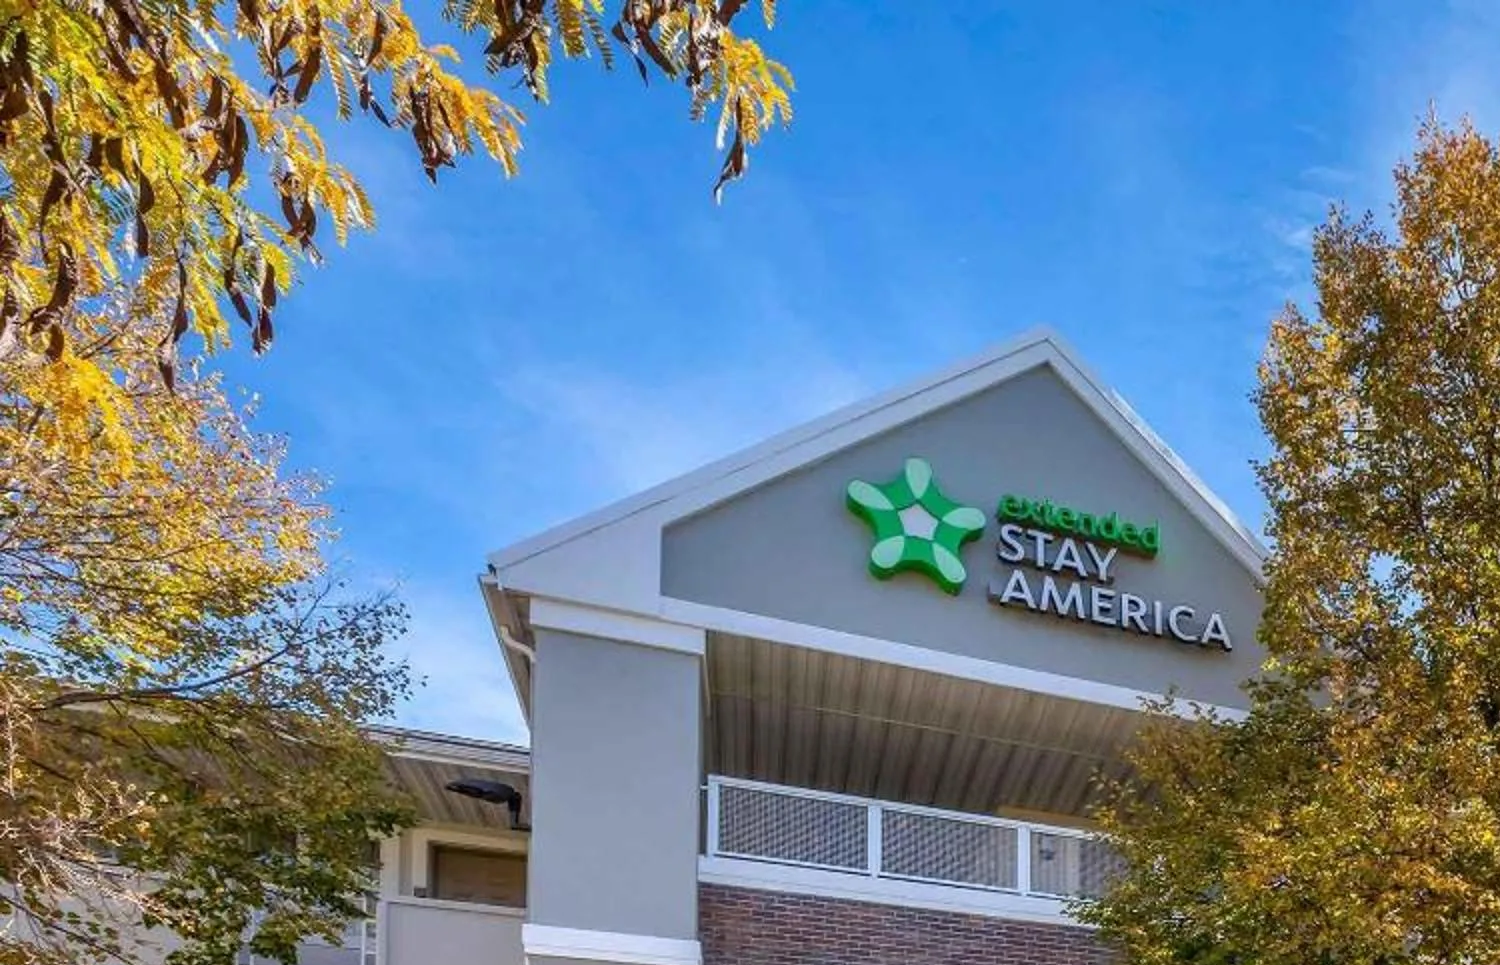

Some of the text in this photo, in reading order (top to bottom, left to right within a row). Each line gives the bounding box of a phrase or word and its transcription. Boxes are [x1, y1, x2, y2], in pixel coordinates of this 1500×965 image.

[999, 523, 1118, 583] STAY
[1000, 494, 1161, 555] extended
[1000, 569, 1234, 651] AMERICA
